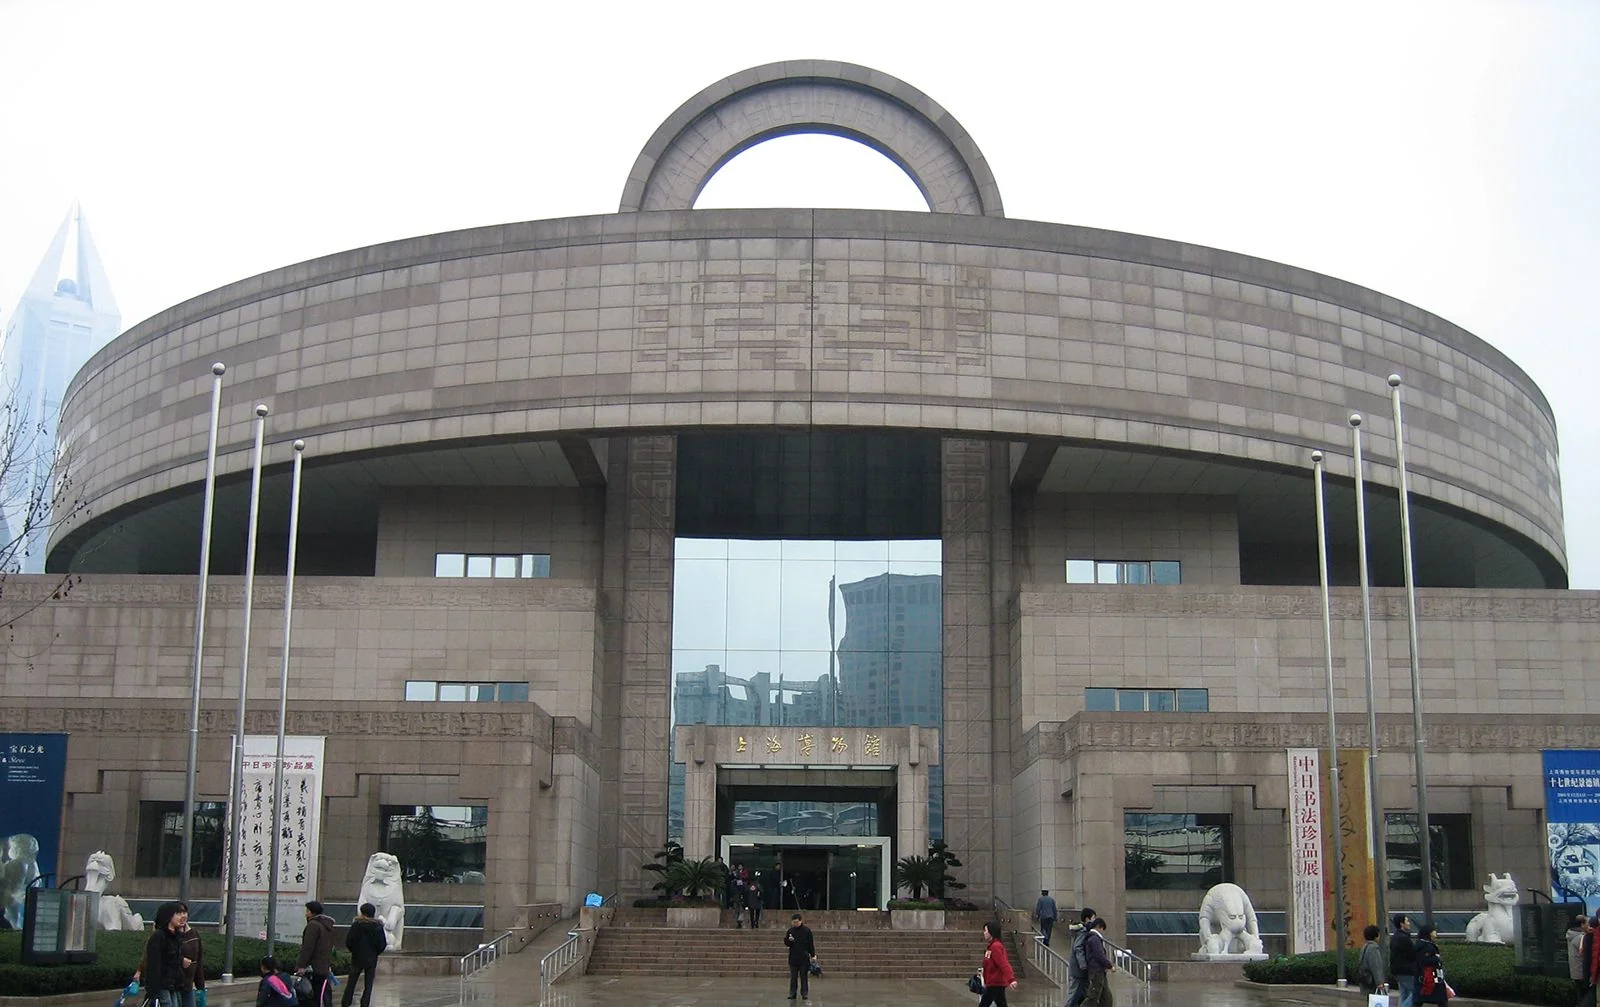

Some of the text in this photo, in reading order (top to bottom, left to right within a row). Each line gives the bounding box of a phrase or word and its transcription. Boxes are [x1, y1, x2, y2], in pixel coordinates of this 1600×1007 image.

[9, 744, 45, 754] 宝石之光
[1299, 756, 1319, 876] 中日书法珍品展
